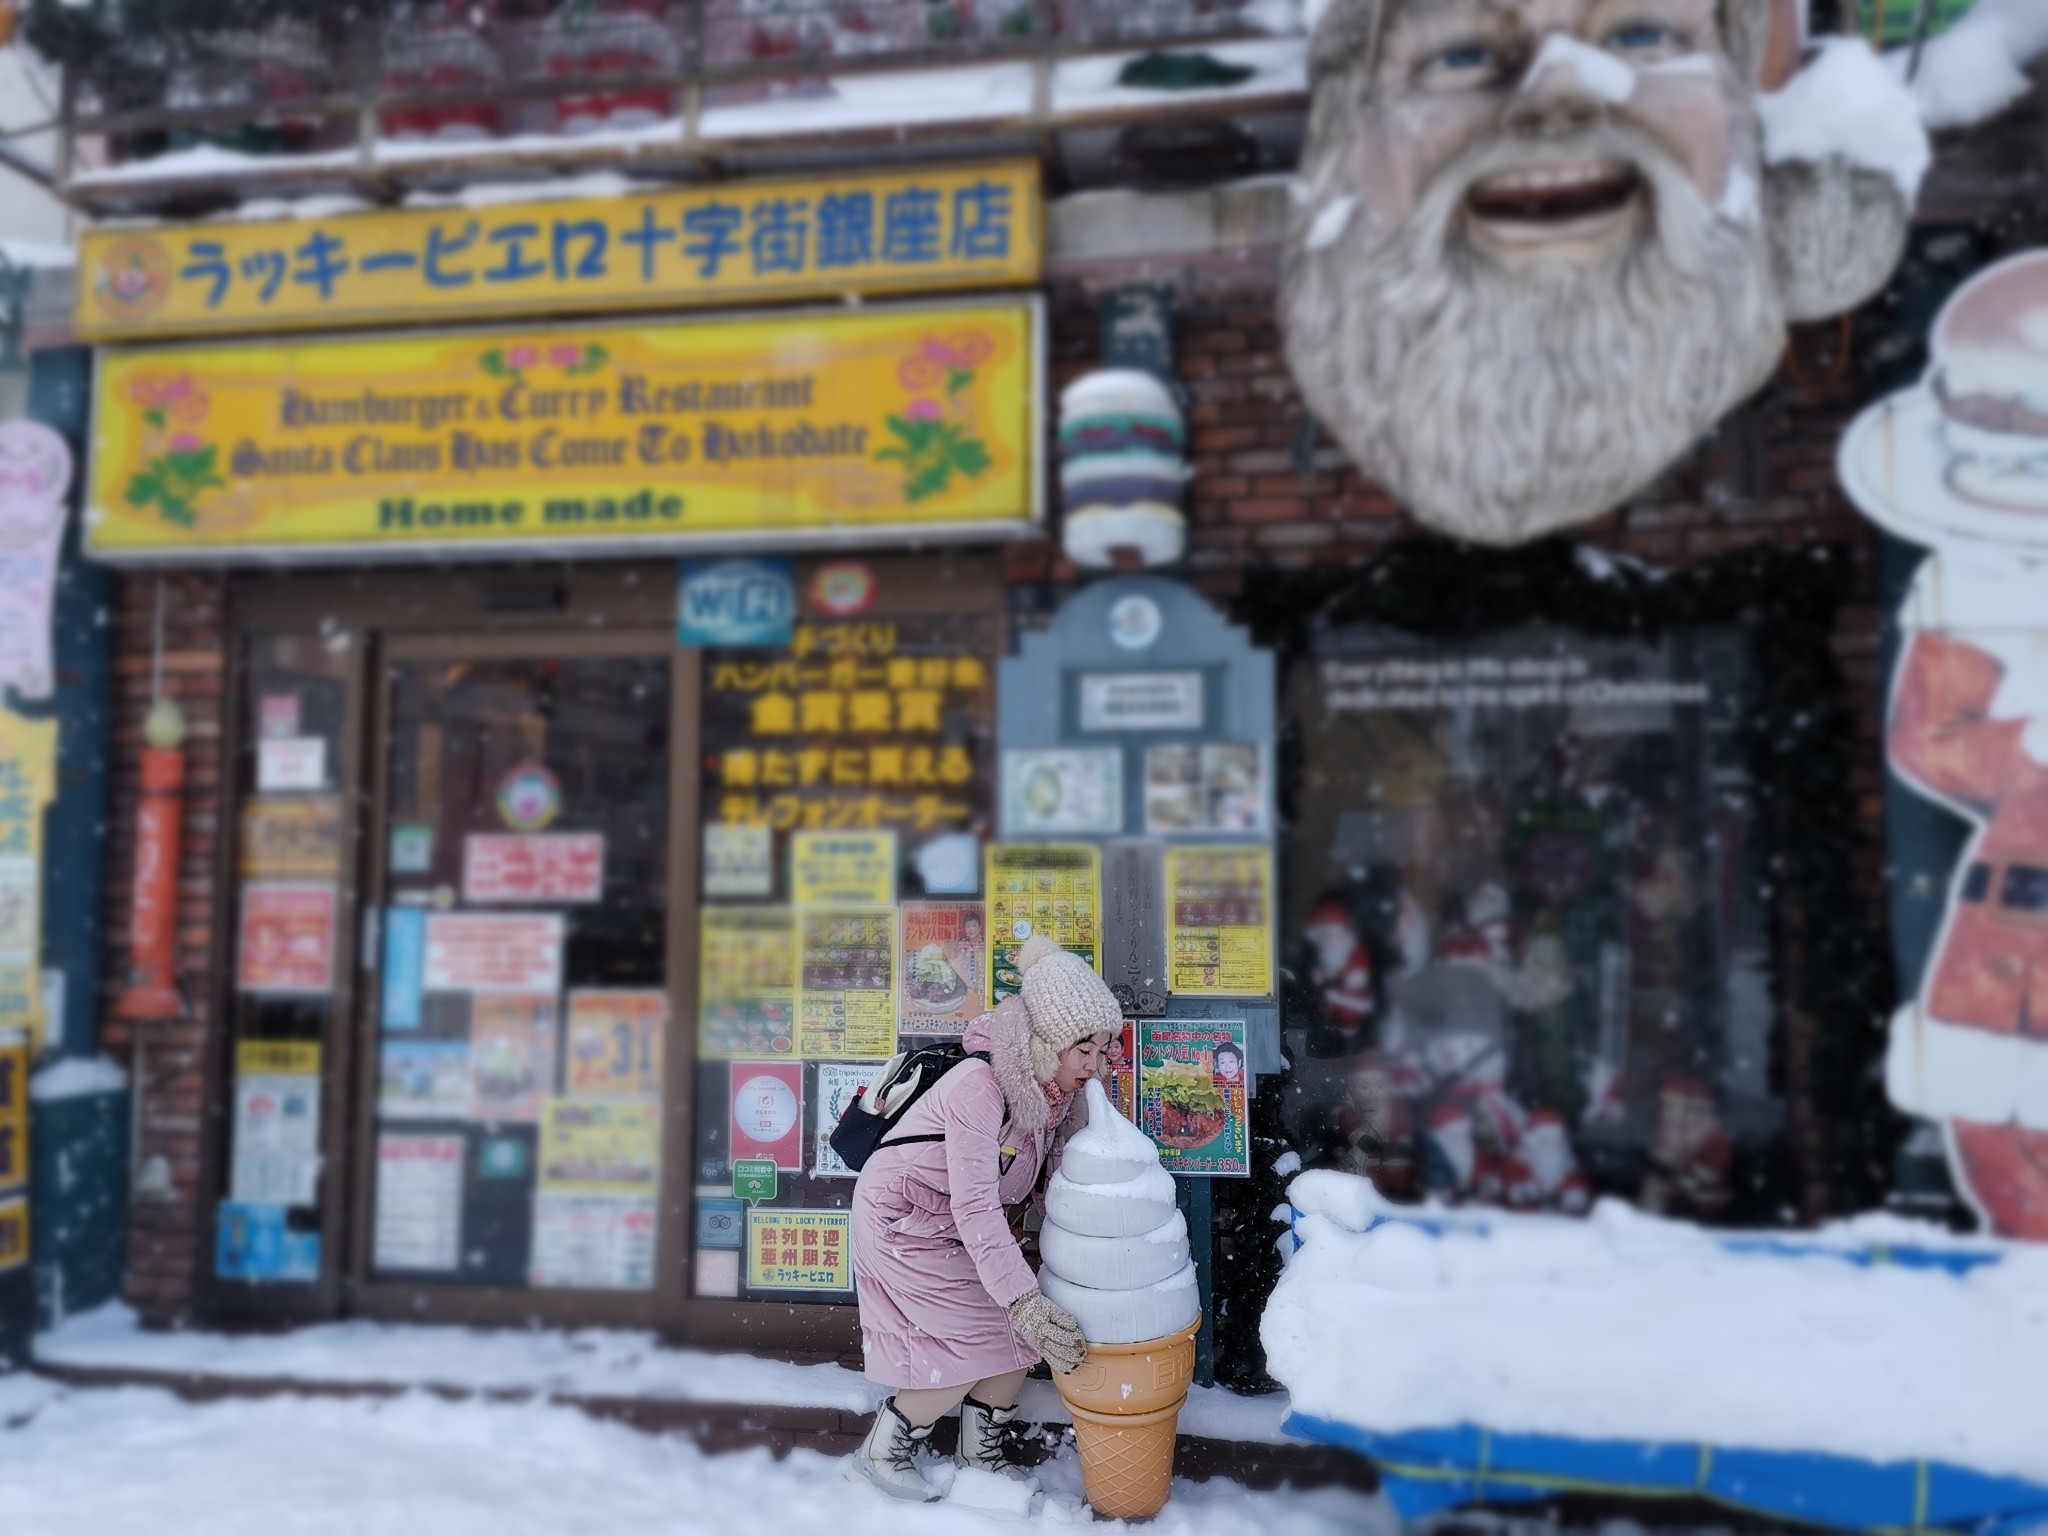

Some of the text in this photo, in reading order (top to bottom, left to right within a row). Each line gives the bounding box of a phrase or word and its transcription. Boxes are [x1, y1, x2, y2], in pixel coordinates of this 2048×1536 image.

[181, 179, 1012, 307] ラッキーピエロ十字街銀座店
[280, 385, 467, 432] Hamburger
[499, 379, 608, 428] Curry
[618, 374, 815, 415] Restaurant
[230, 441, 334, 477] Santa
[342, 433, 442, 473] Claus
[449, 431, 521, 475] Has
[529, 428, 628, 469] Come
[638, 425, 690, 464] To
[377, 488, 685, 530] Home made
[839, 1069, 874, 1077] tripadvisor
[845, 1079, 871, 1087] レストラン
[753, 1216, 780, 1224] WELCOME
[796, 1217, 815, 1225] LUCKY
[820, 1217, 846, 1226] PIERROT
[761, 1248, 839, 1267] 亜州朋友
[777, 1268, 834, 1283] ラッキーピエロ
